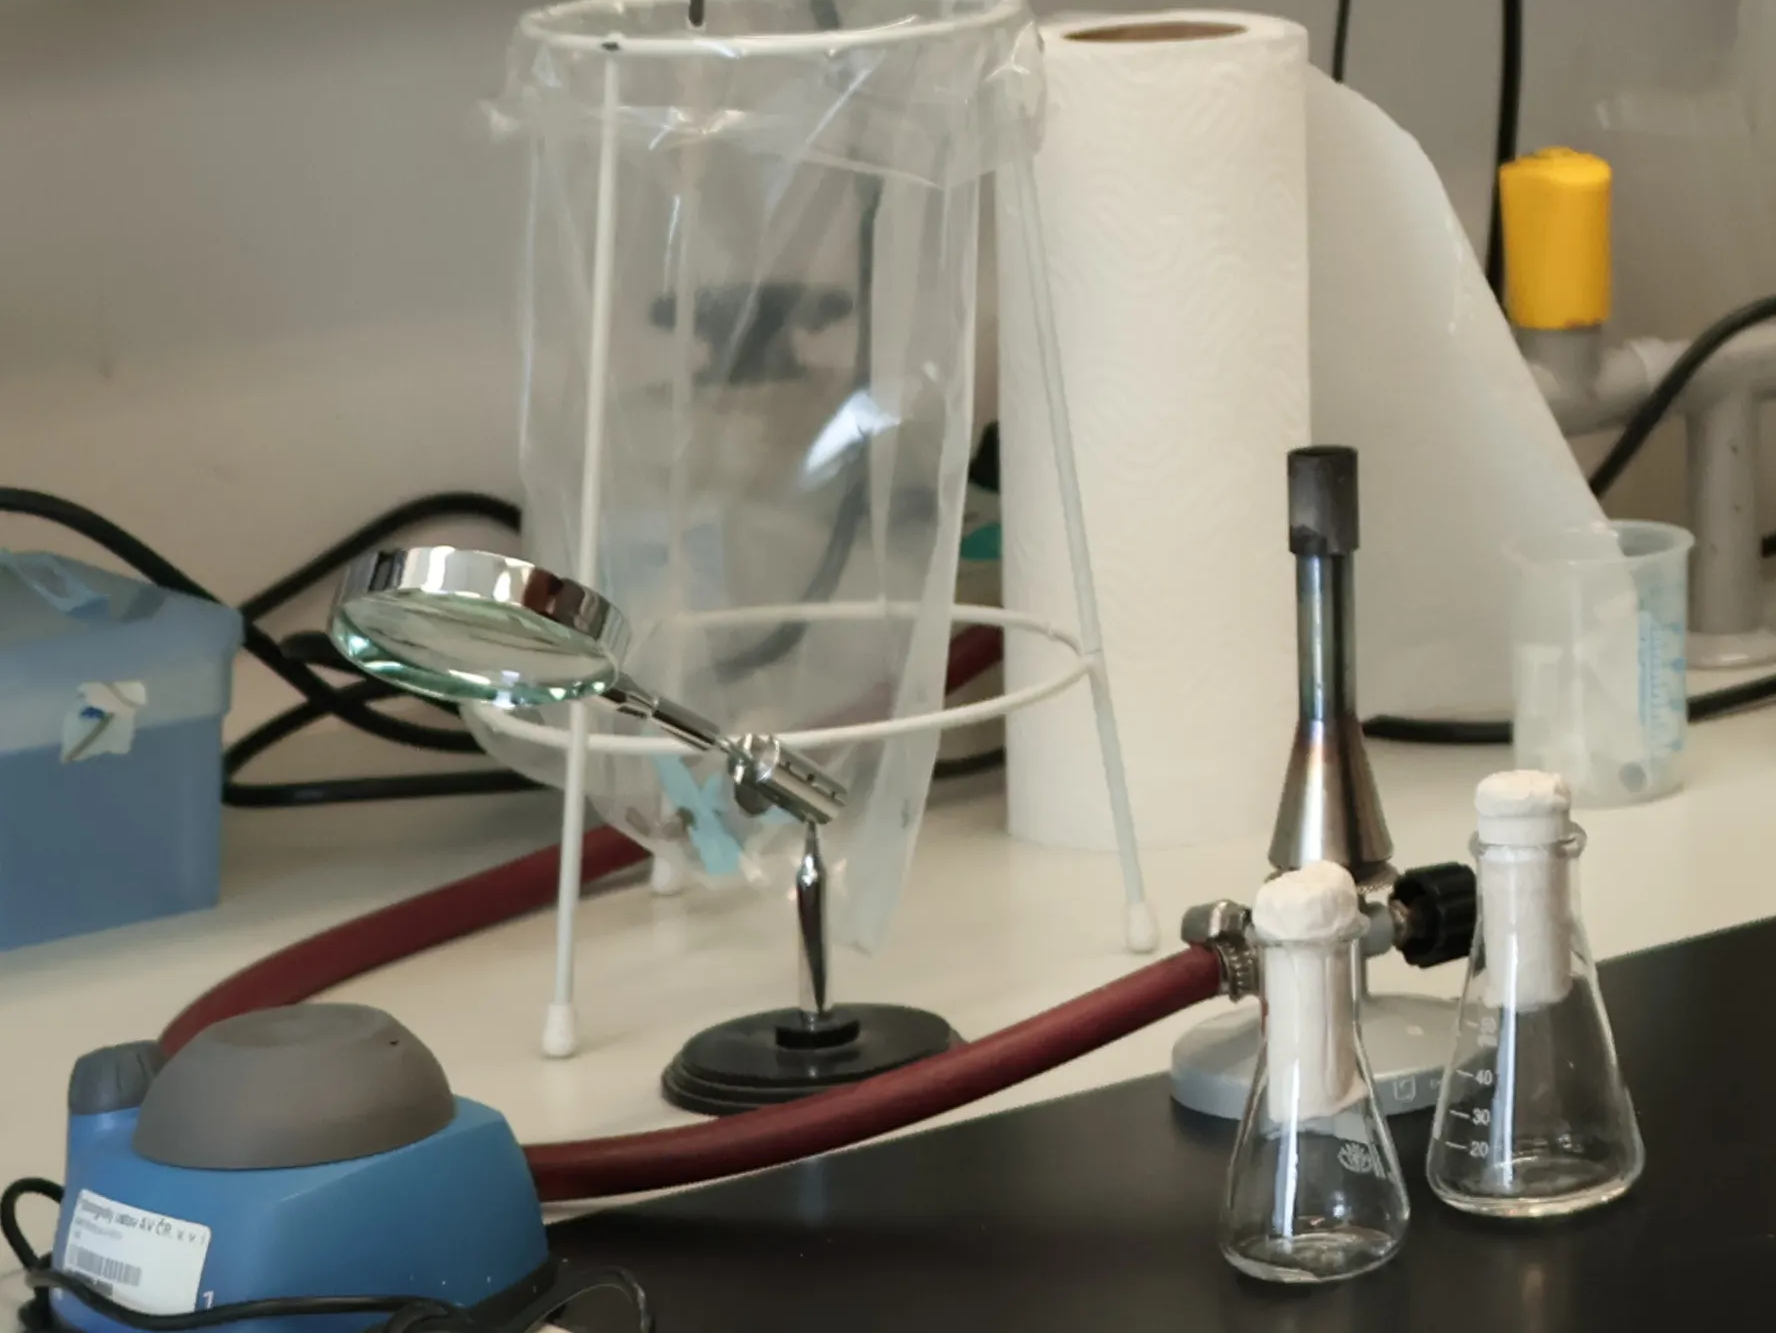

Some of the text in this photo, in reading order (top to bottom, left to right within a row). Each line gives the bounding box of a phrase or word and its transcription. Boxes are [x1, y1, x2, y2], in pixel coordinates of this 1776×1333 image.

[1475, 1069, 1493, 1085] 40
[1472, 1108, 1491, 1126] 30
[1469, 1140, 1489, 1158] 20
